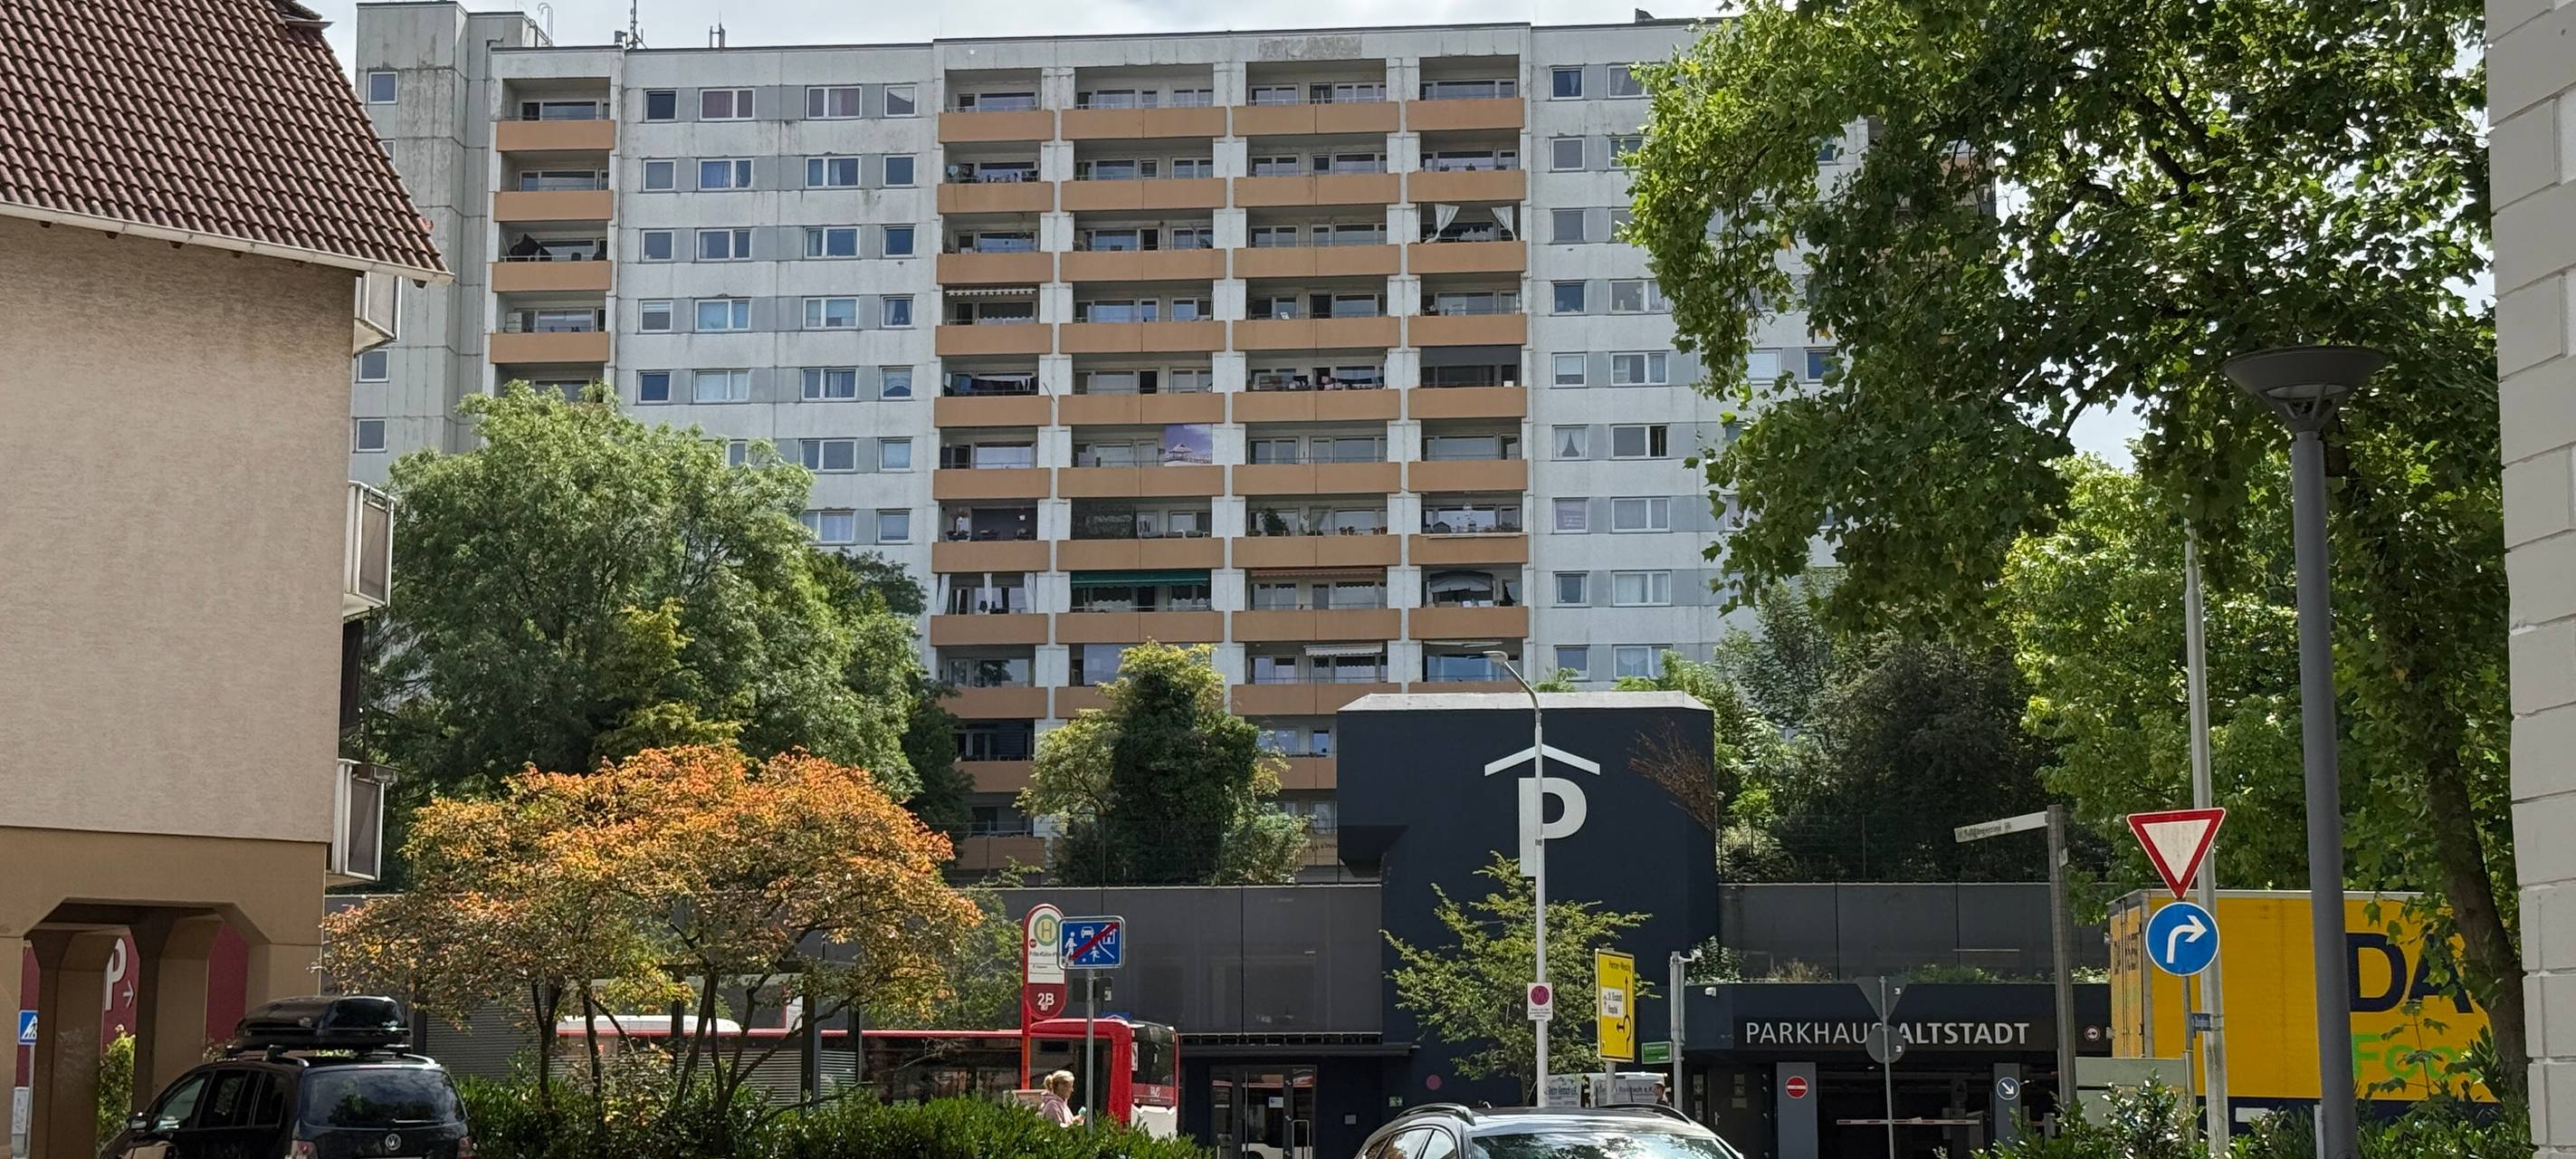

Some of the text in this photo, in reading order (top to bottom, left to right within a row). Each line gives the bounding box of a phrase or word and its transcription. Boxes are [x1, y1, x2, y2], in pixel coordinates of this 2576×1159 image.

[1519, 778, 1588, 876] P
[1041, 921, 1053, 940] H
[105, 938, 128, 1011] P
[1037, 992, 1054, 1005] 2B
[1898, 1022, 2030, 1044] ALTSTADT
